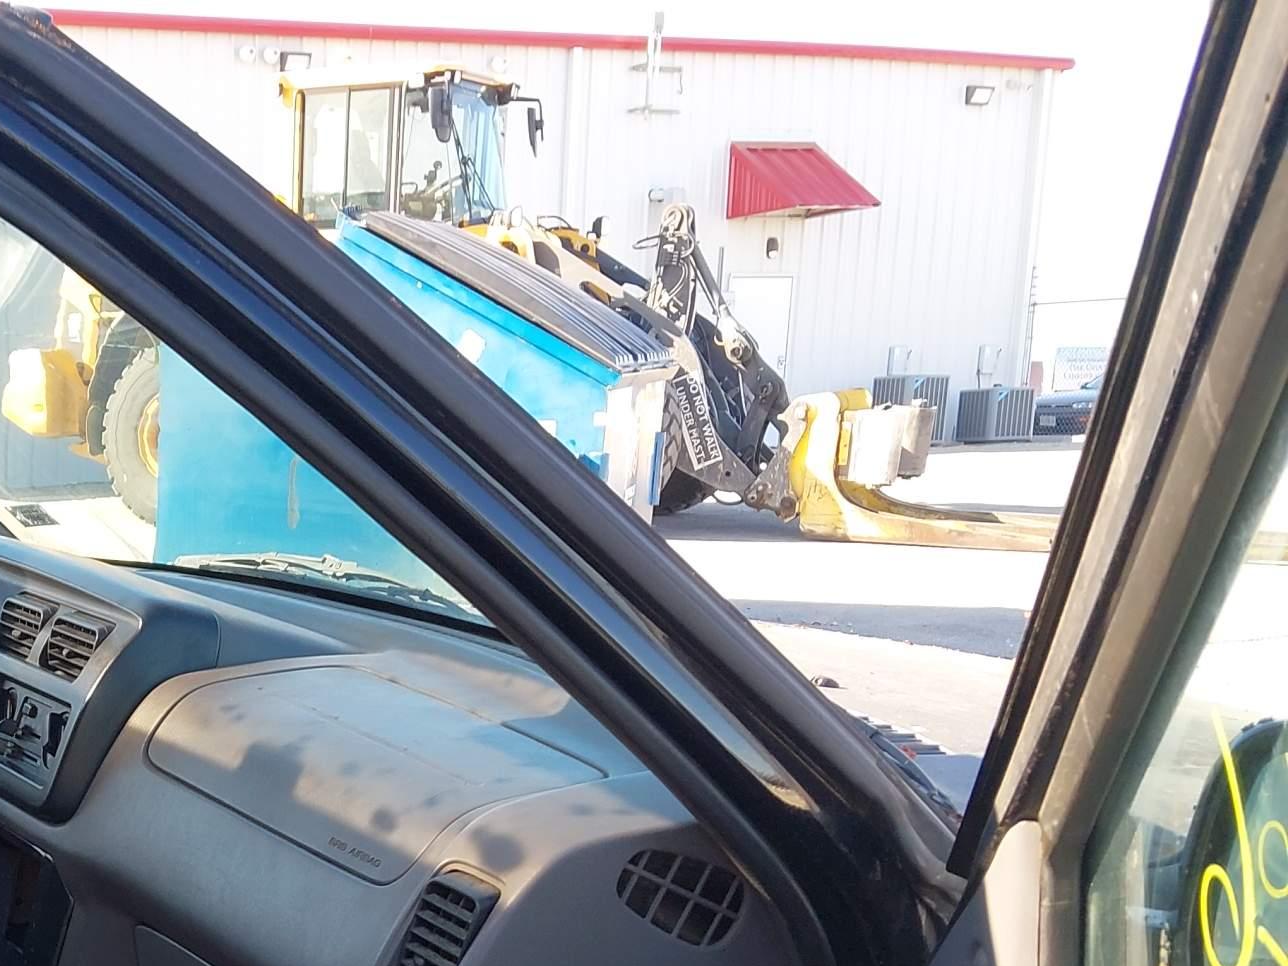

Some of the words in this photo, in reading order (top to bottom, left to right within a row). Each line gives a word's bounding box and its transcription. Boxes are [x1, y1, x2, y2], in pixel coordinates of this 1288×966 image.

[676, 386, 694, 426] UNDER
[692, 394, 708, 421] NOT
[702, 421, 719, 460] WALK
